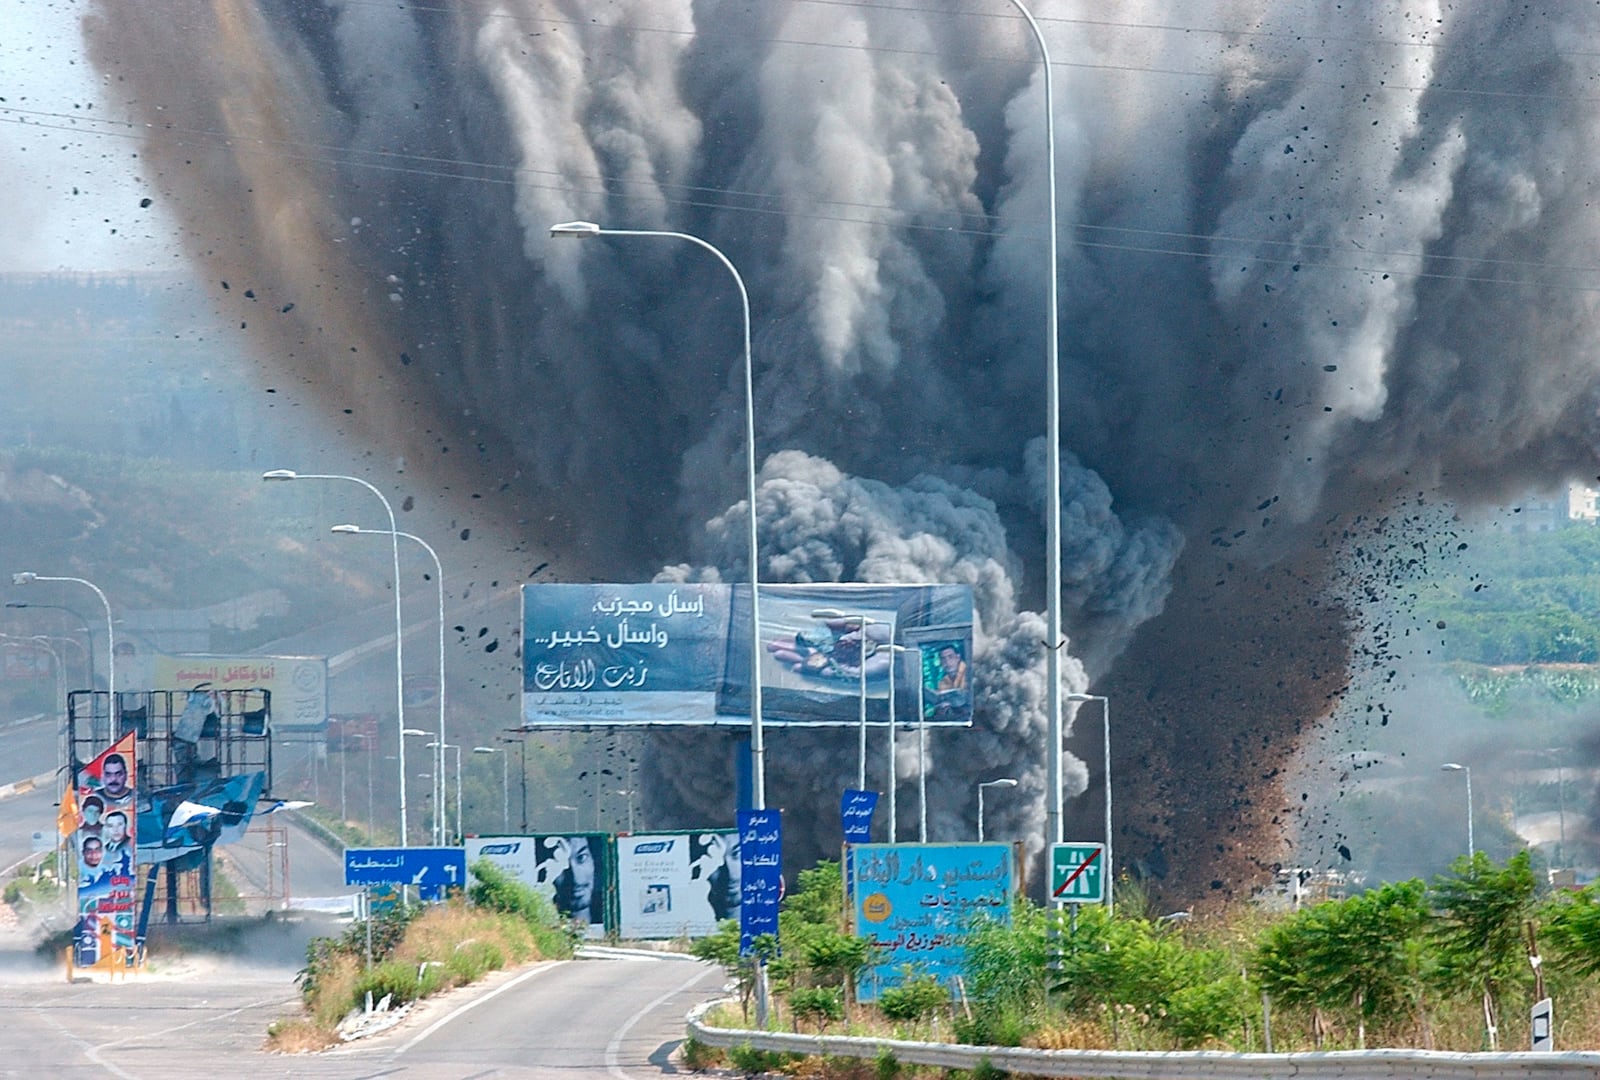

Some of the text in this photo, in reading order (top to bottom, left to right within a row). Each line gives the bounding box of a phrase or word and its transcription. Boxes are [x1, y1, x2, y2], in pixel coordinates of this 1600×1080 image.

[658, 590, 704, 618] إسأل
[607, 618, 669, 649] واسأل
[349, 855, 404, 872] النبطية
